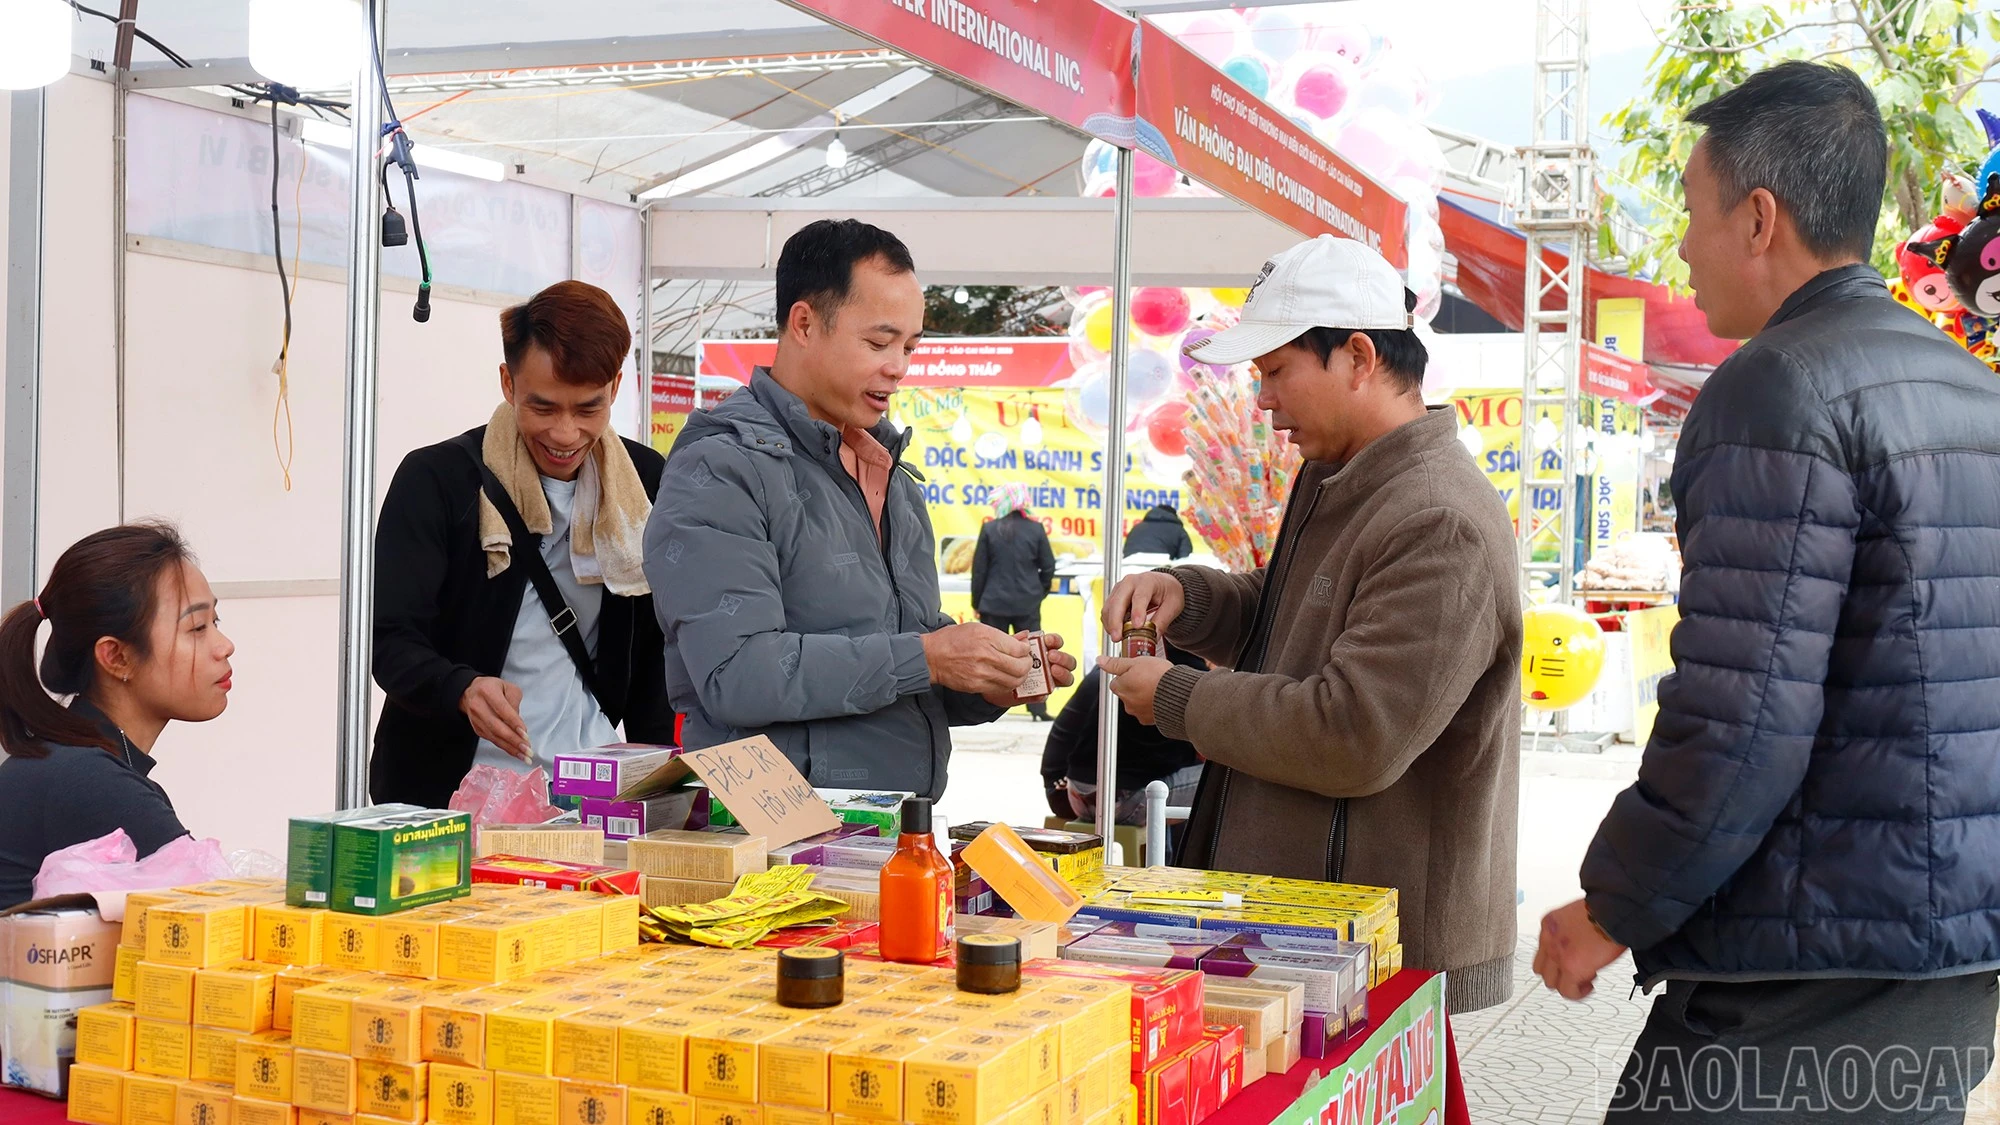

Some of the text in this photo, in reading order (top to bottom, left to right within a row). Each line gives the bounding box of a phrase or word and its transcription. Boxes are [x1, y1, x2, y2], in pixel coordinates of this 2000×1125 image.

[931, 0, 1085, 95] INTERNATIONAL INC.
[1211, 83, 1223, 105] HỘI
[1222, 91, 1236, 115] CHỢ
[1235, 100, 1248, 119] XÚC
[1174, 104, 1197, 145] VĂN
[1199, 122, 1235, 167] PHÒNG
[1236, 145, 1254, 183] ĐẠI
[1255, 157, 1276, 194] DIỆN
[1276, 171, 1315, 214] COWATER
[1316, 195, 1368, 246] INTERNATIONAL
[906, 363, 925, 376] NH
[968, 360, 1003, 376] THÁP
[924, 441, 968, 473] ĐẶC
[1023, 445, 1082, 472] BÁNH
[962, 477, 995, 506] SẢ
[1074, 484, 1101, 509] TÂ
[1126, 489, 1180, 510] NAM
[1061, 516, 1096, 537] 901
[402, 819, 466, 842] ยาสมุนไพรไทย
[1372, 1005, 1435, 1125] TẠNG
